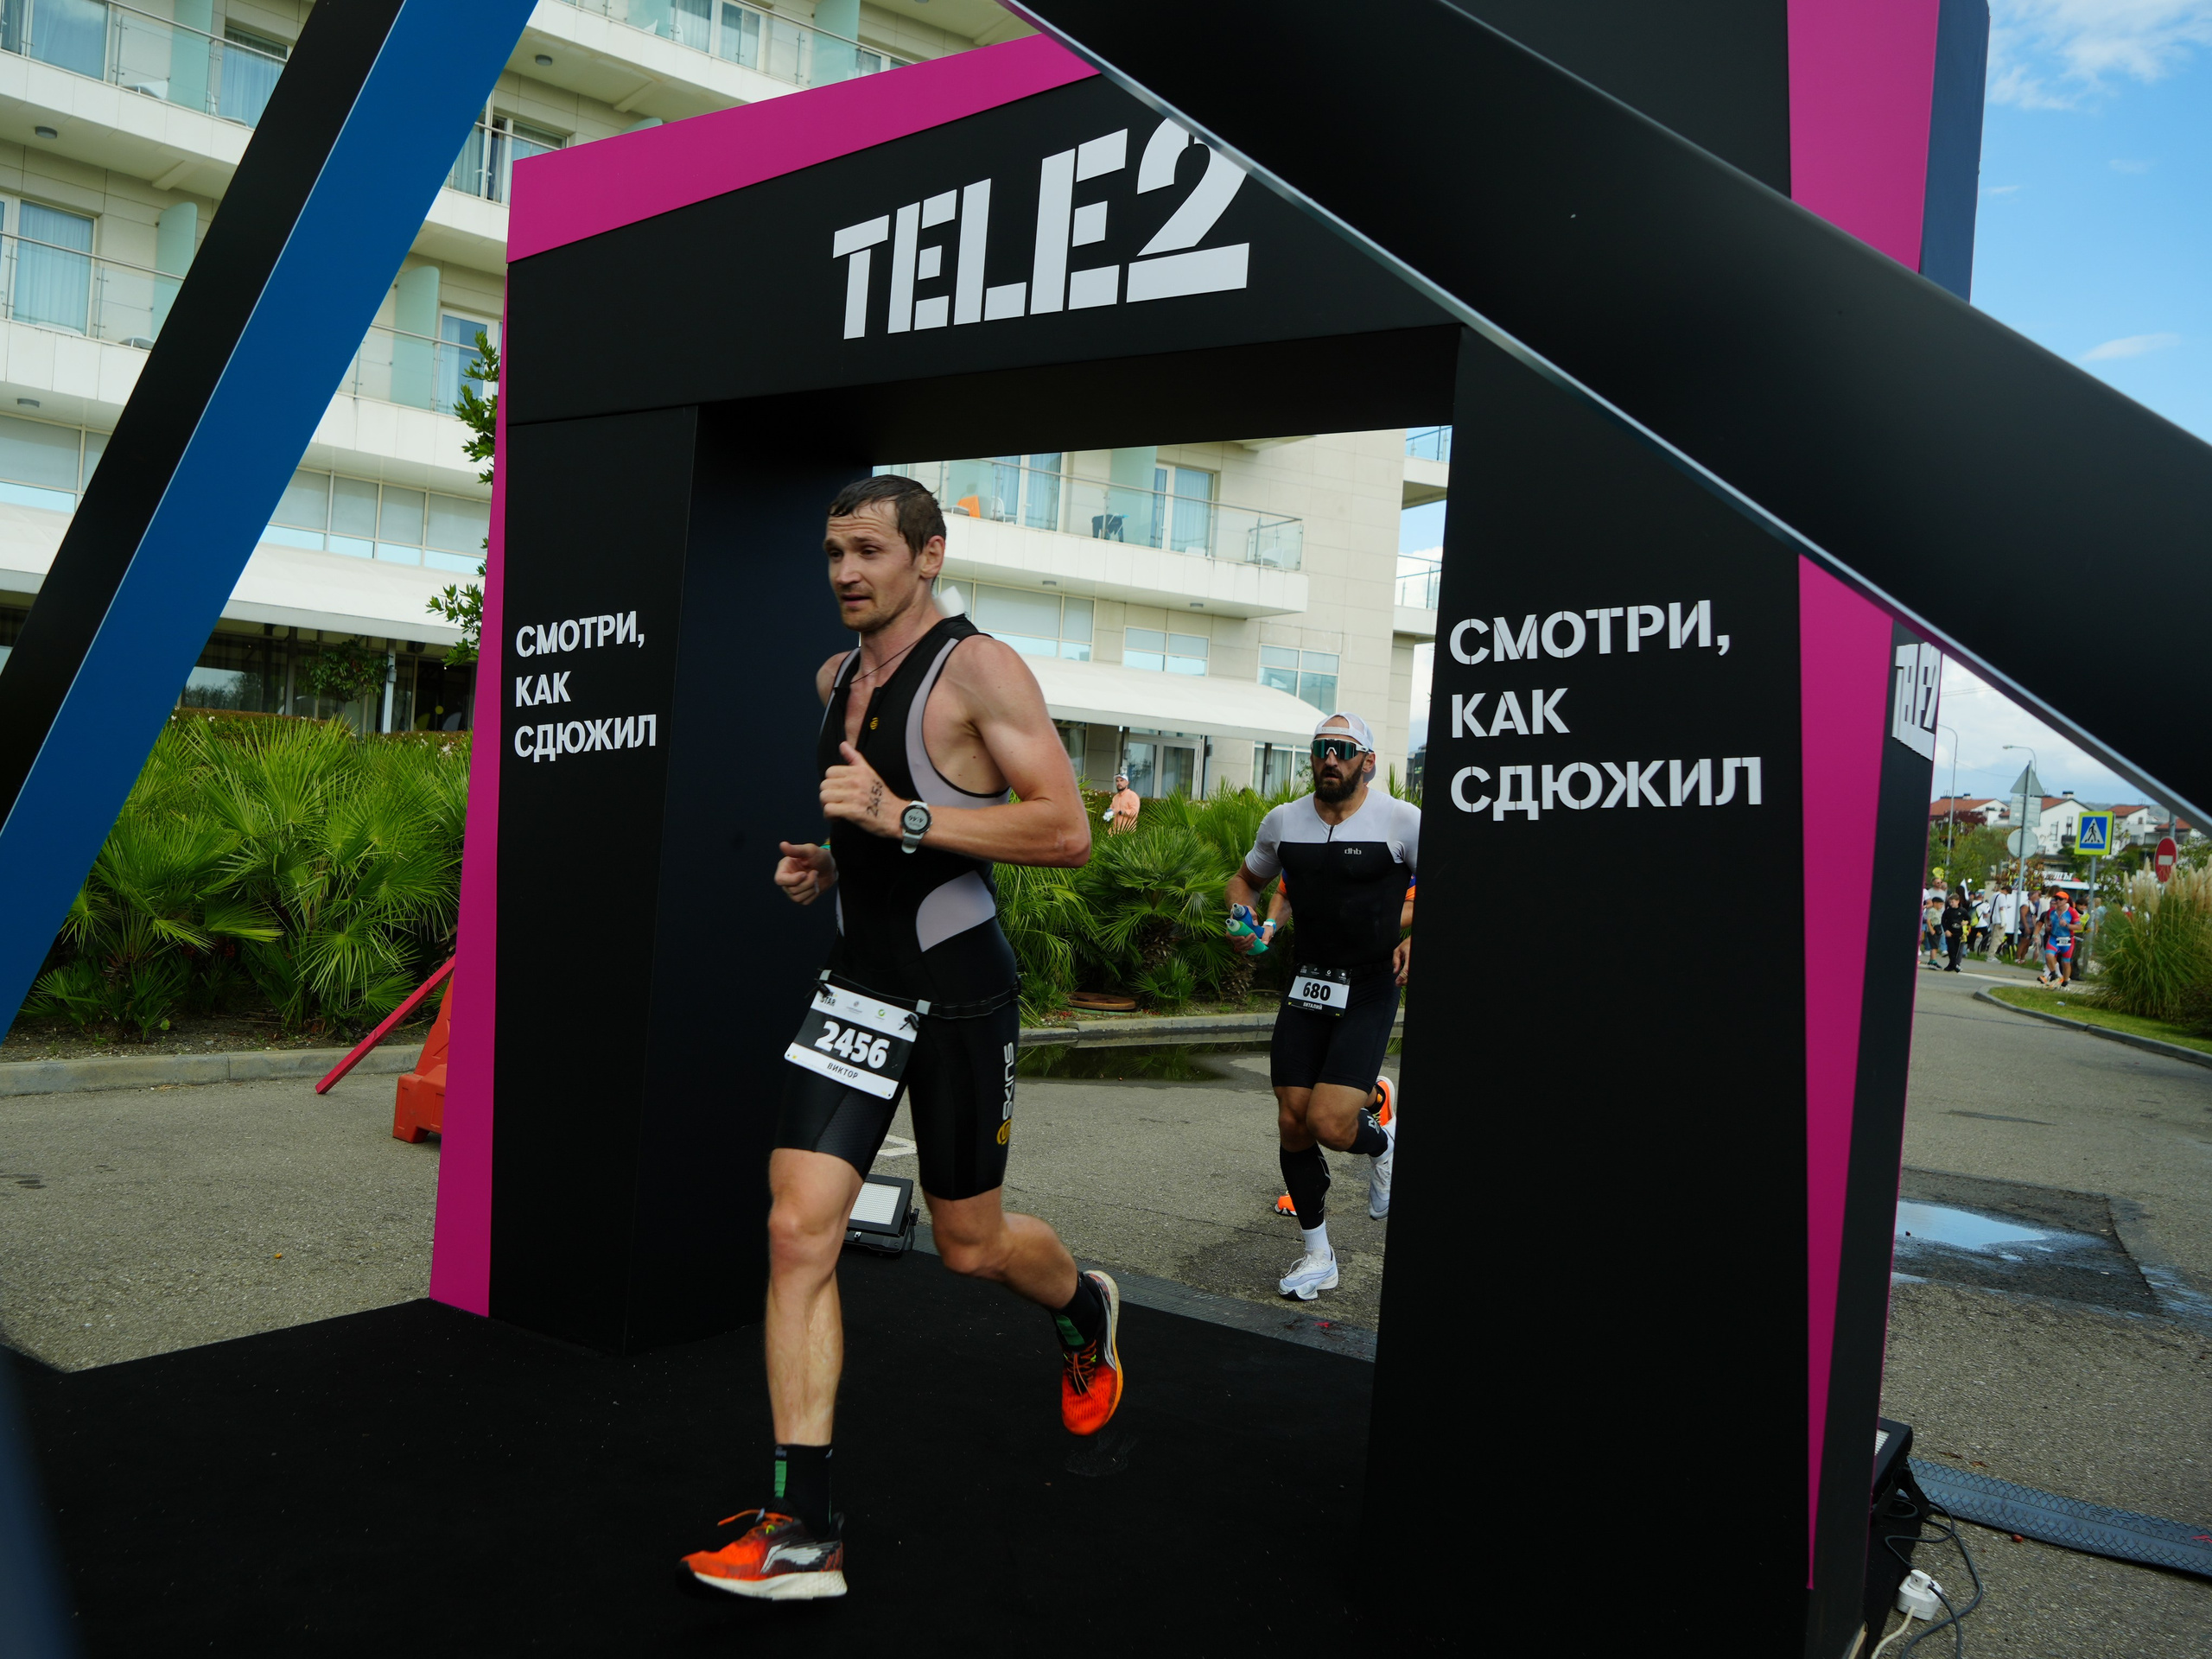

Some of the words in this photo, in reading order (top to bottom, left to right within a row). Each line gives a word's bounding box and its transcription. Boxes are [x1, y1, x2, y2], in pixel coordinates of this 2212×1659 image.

[833, 118, 1249, 340] TELE2
[516, 611, 645, 658] СМОТРИ,
[1449, 600, 1730, 664] СМОТРИ,
[516, 671, 571, 707] КАК
[1452, 688, 1570, 738] КАК
[514, 714, 657, 763] СДЮЖИЛ
[1451, 756, 1762, 822] СДЮЖИЛ
[1303, 982, 1331, 1001] 680
[814, 1020, 890, 1069] 2456
[827, 1062, 859, 1079] ВИКТОР
[1002, 1042, 1014, 1121] SKINS
